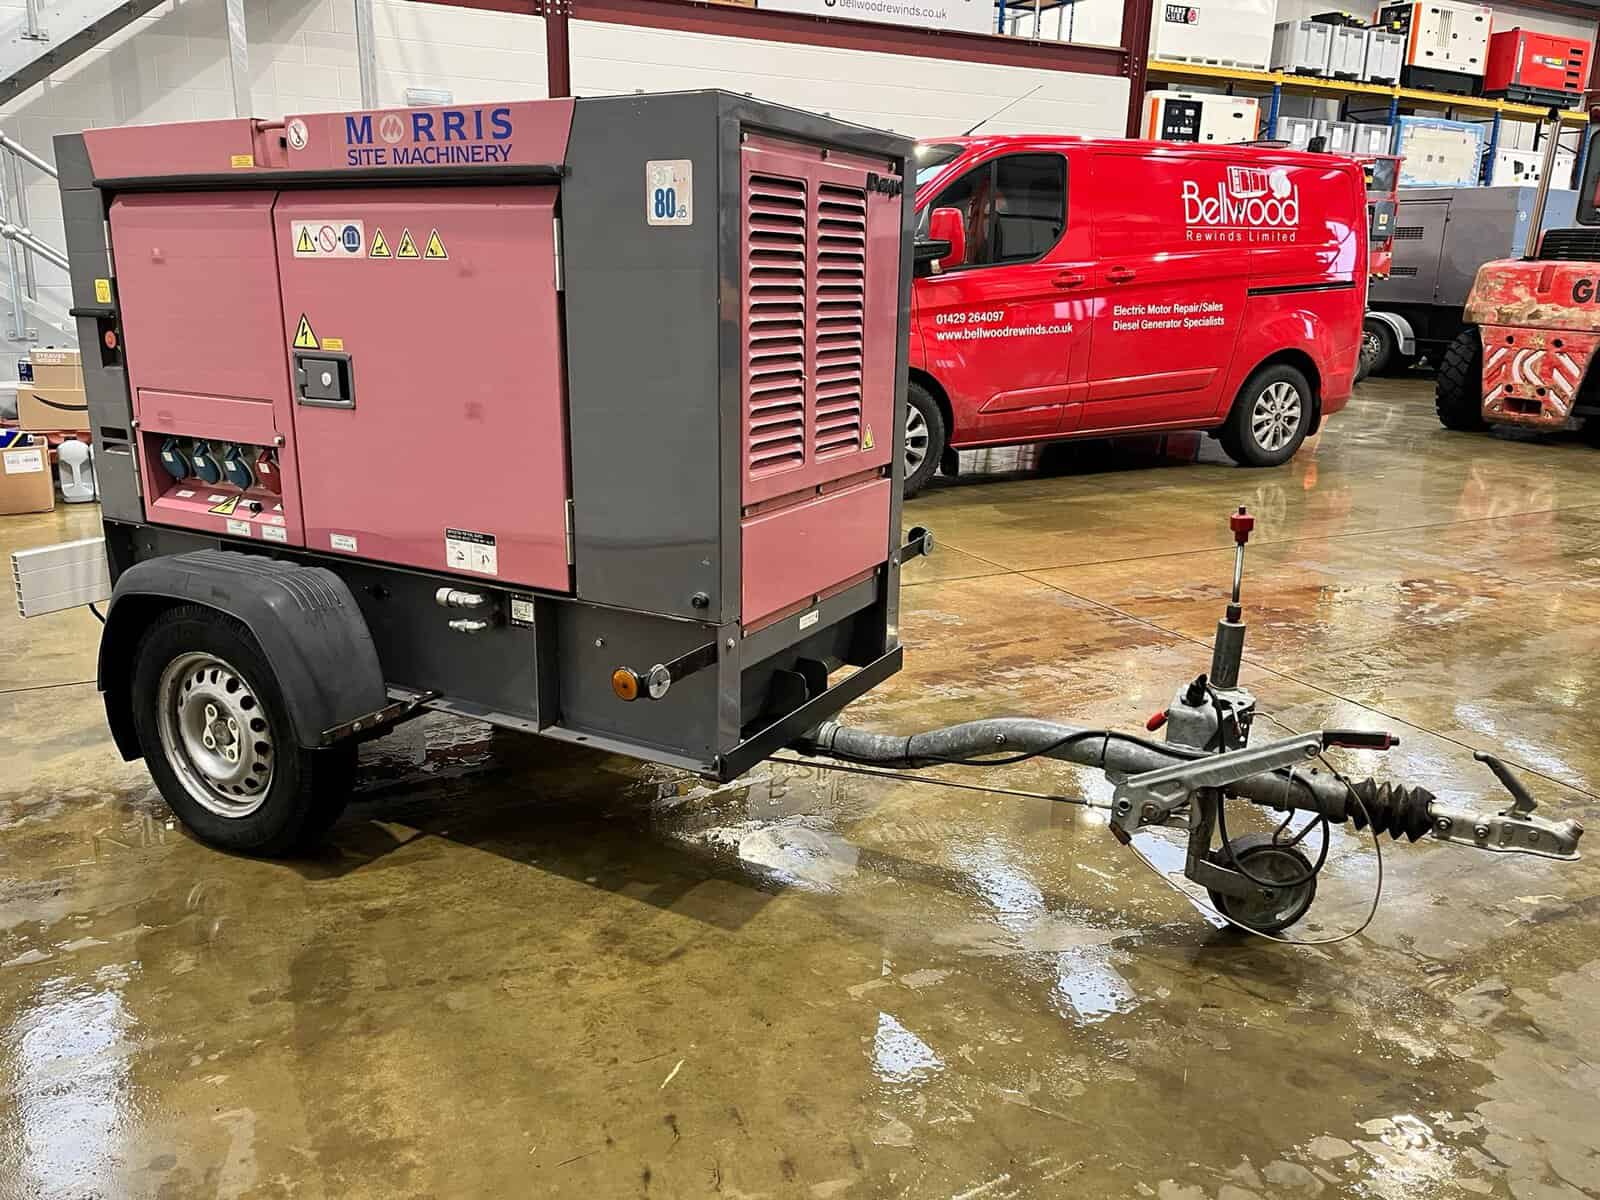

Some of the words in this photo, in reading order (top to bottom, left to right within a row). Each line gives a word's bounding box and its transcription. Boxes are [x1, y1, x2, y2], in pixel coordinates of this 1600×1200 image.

[839, 0, 948, 19] bellwoodrewinds.co.uk
[347, 148, 387, 166] SITE
[393, 144, 513, 165] MACHINERY
[655, 188, 676, 218] 80
[1181, 181, 1299, 226] Bellwood
[1186, 230, 1242, 242] Rewinds
[1249, 231, 1296, 242] Limited
[936, 312, 966, 325] 01429
[967, 311, 1005, 324] 264097
[1113, 304, 1146, 316] Electric
[1147, 304, 1172, 315] Motor
[1173, 301, 1224, 316] Repair/Sales
[936, 322, 1073, 341] www.bellwoodrewinds.co.uk
[1113, 320, 1140, 331] Diesel
[1141, 318, 1182, 330] Generator
[1183, 316, 1225, 329] Specialists
